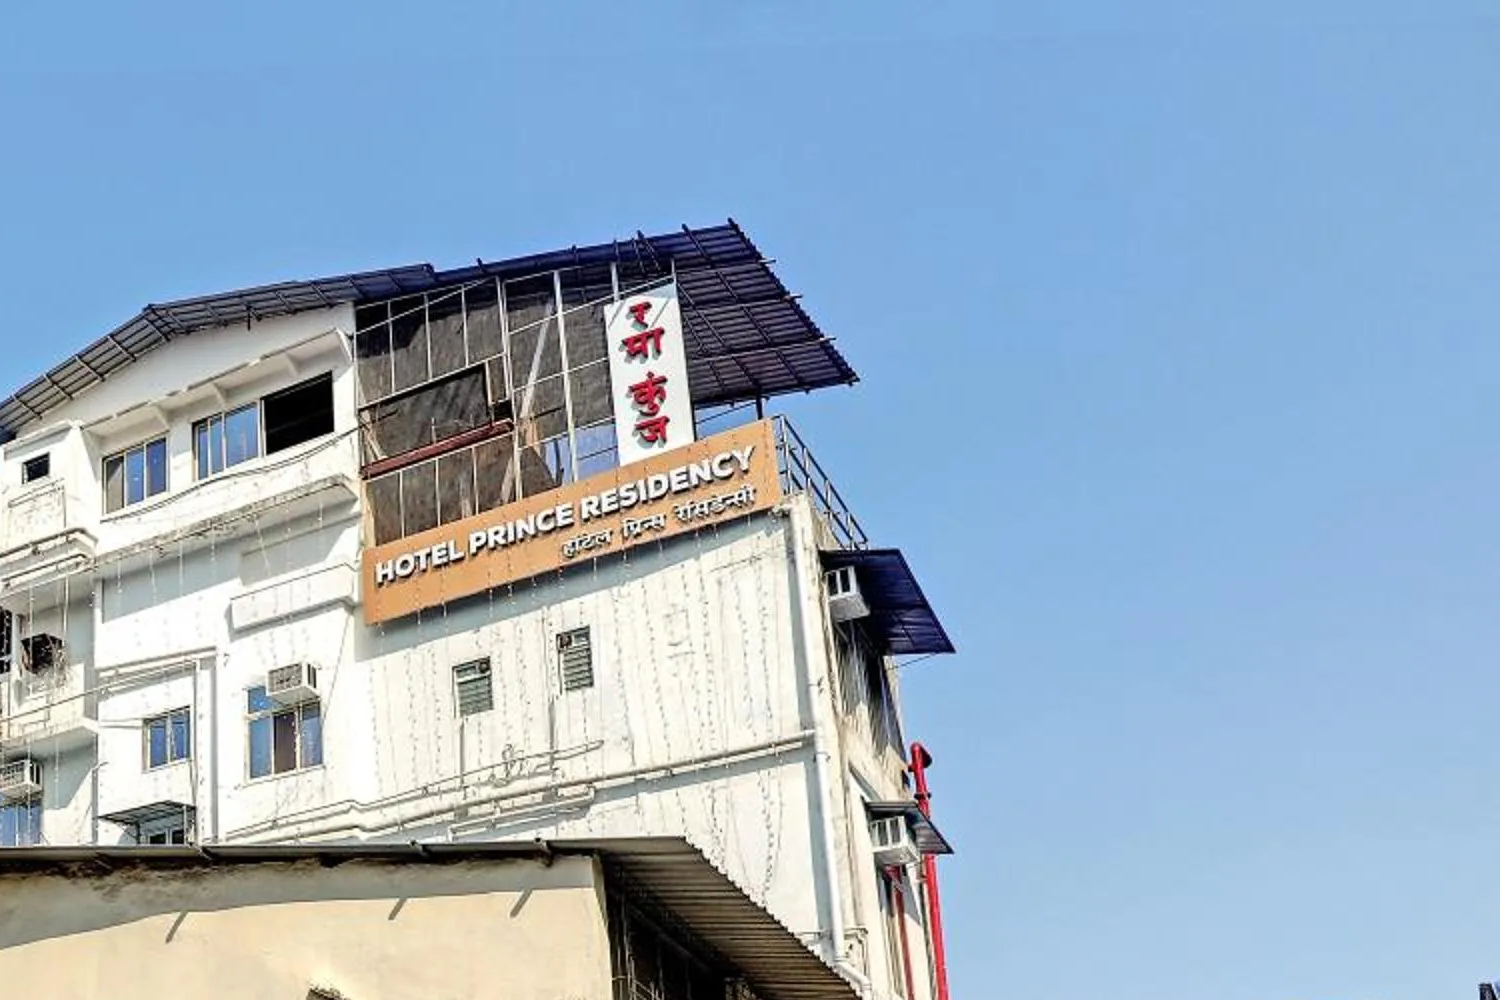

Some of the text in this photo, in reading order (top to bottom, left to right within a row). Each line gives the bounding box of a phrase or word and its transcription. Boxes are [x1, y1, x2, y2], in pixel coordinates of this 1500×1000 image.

[375, 445, 756, 586] HOTEL PRINCE RESIDENCY
